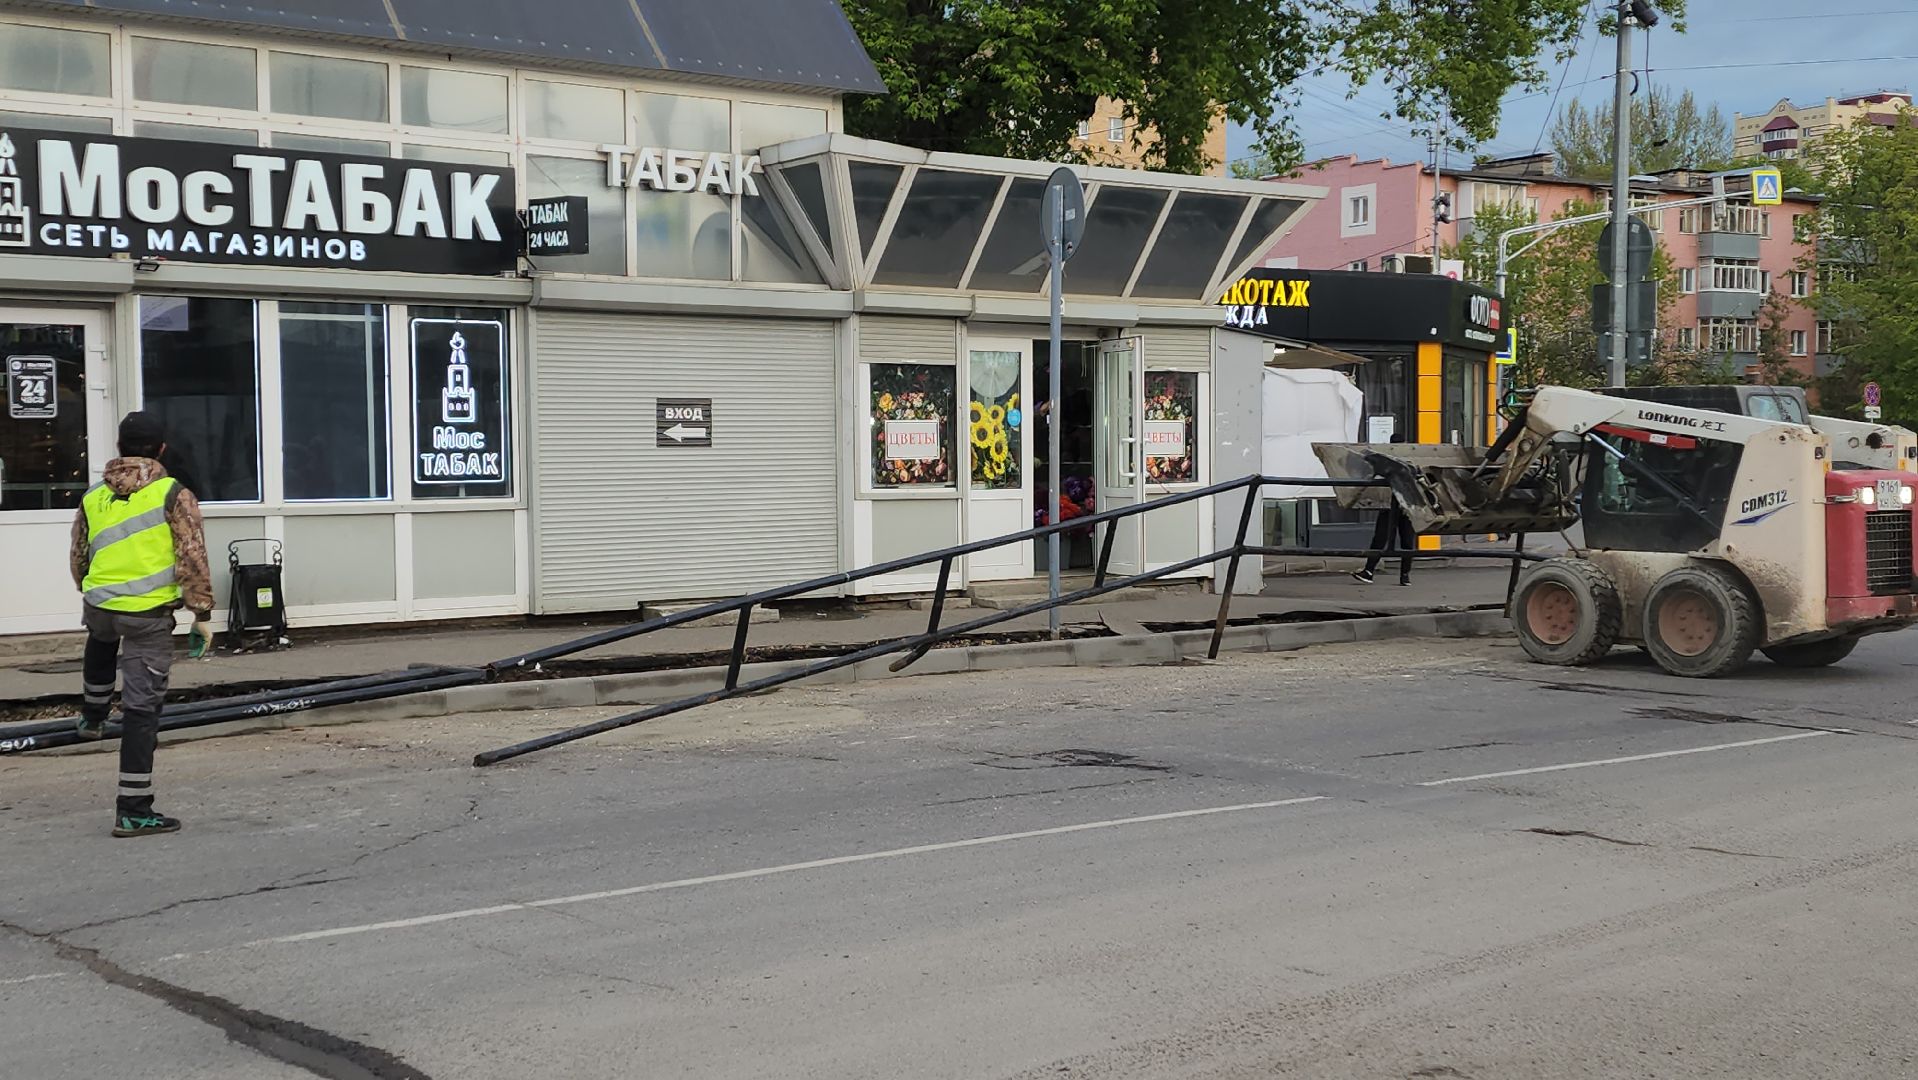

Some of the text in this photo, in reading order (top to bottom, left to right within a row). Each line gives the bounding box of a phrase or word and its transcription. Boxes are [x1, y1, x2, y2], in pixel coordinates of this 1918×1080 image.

[597, 143, 761, 197] ТАБАК
[37, 139, 502, 241] МосТАБАК
[529, 201, 569, 225] ТАБАК
[40, 222, 367, 262] СЕТЬ МАГАЗИНОВ
[530, 230, 569, 248] 24 ЧАСА
[20, 379, 47, 397] 24
[664, 407, 703, 421] ВХОД
[432, 425, 485, 450] Мос
[889, 432, 936, 447] ЦВЕТЫ
[420, 452, 499, 476] ТАБАК
[1741, 490, 1788, 514] CDM312
